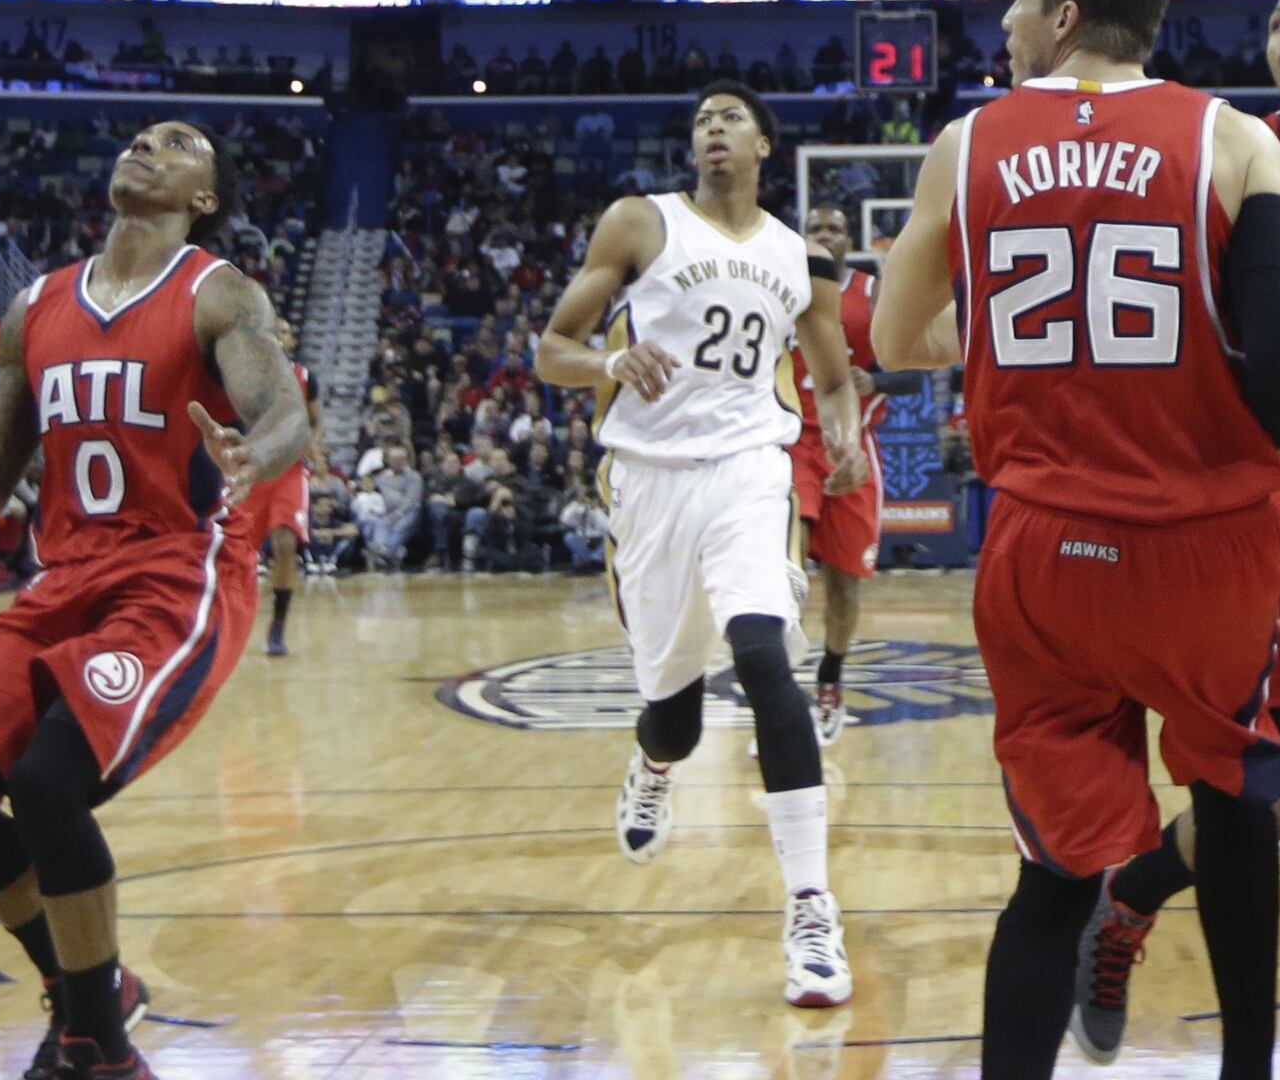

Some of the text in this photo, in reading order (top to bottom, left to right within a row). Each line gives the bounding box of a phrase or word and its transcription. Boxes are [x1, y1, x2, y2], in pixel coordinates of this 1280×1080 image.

[870, 41, 924, 84] 21
[997, 140, 1162, 205] KORVER
[673, 259, 798, 314] NEW ORLEANS
[989, 223, 1181, 366] 26
[694, 304, 767, 379] 23
[40, 360, 166, 433] ATL
[75, 439, 126, 515] 0
[1060, 541, 1119, 563] HAWKS
